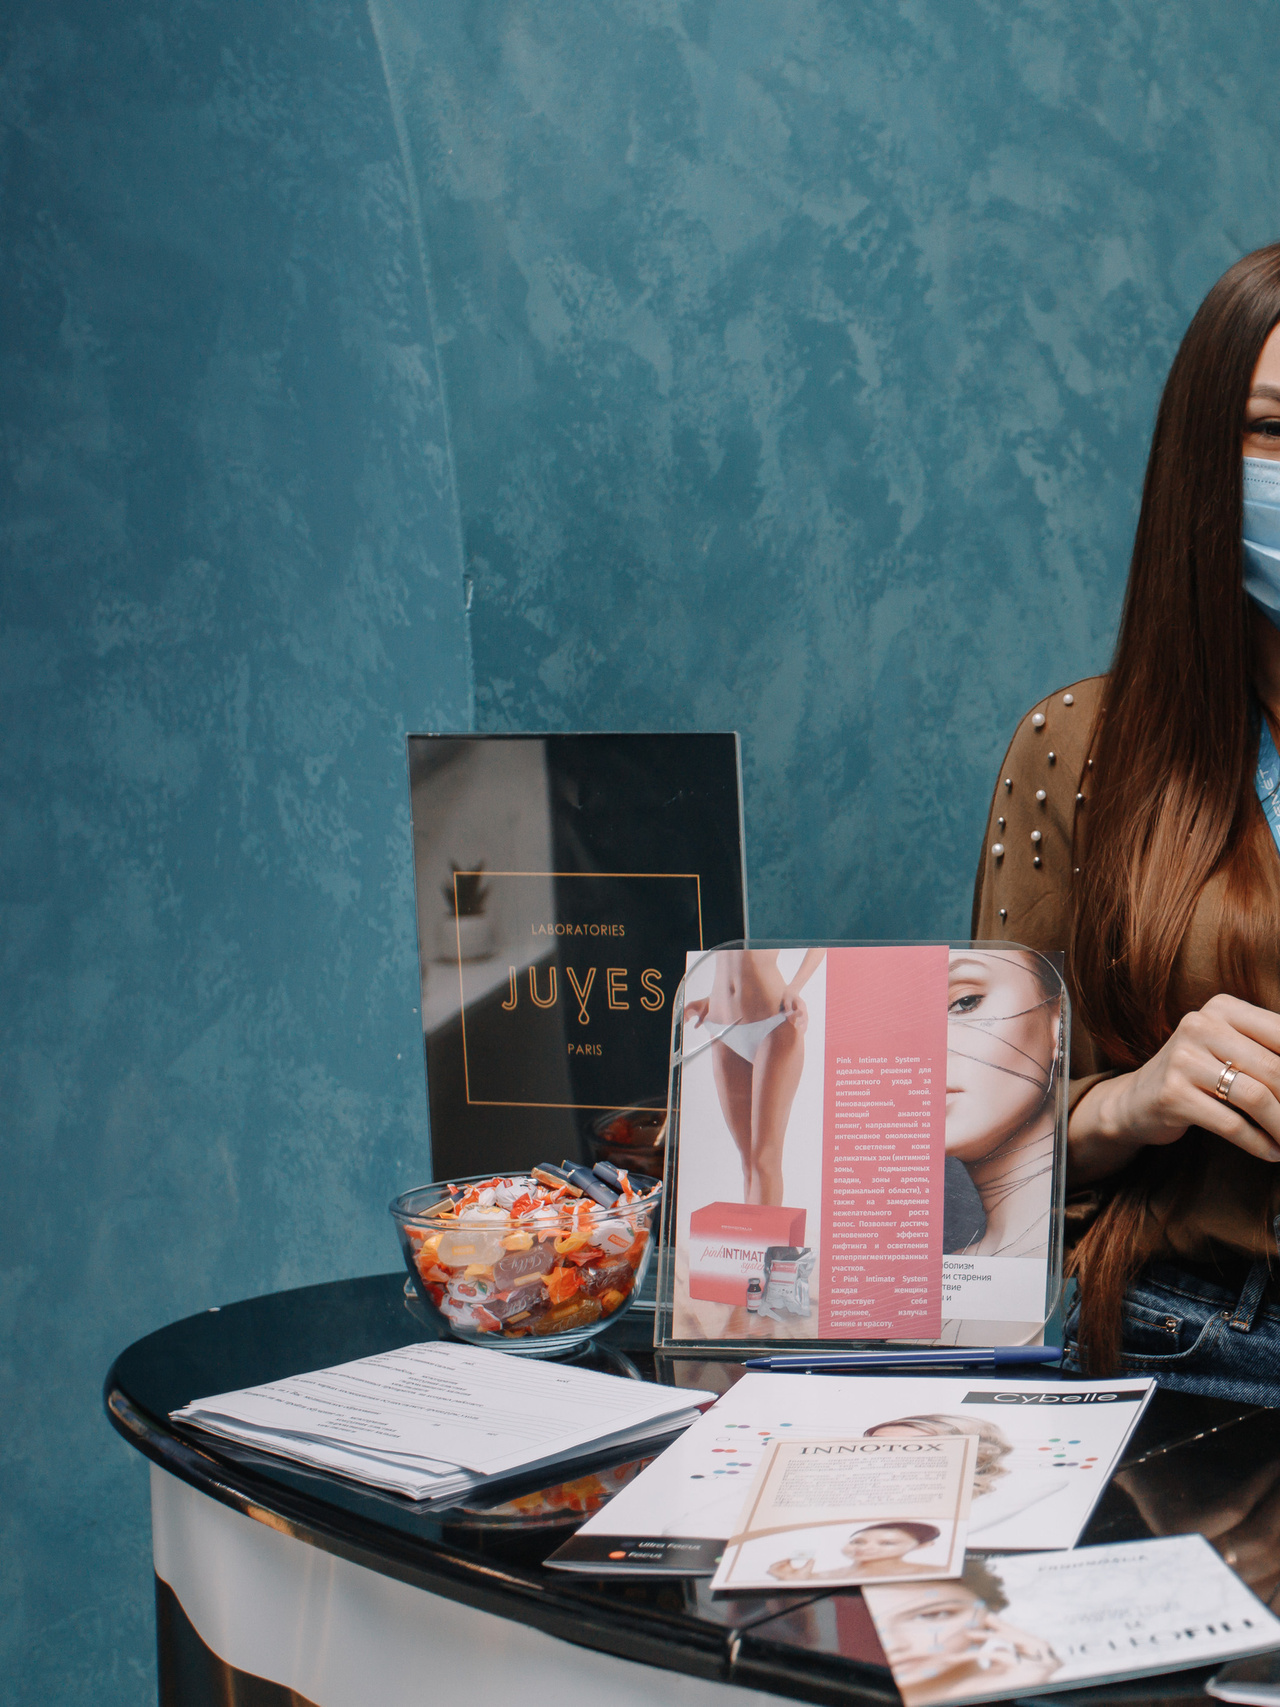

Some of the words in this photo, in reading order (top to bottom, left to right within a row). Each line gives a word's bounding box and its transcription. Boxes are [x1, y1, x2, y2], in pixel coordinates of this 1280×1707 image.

[531, 923, 625, 938] LABORATORIES
[502, 965, 666, 1025] JUVES
[567, 1042, 603, 1056] PARIS
[892, 1078, 912, 1086] ухода
[836, 1100, 895, 1108] Инновационный,
[866, 1121, 918, 1129] направленный
[892, 1154, 930, 1162] (интимной
[834, 1187, 884, 1196] перианальной
[723, 1249, 767, 1262] INTIMAT
[942, 1262, 974, 1270] болизм
[902, 1275, 928, 1283] System
[953, 1274, 991, 1282] старения
[831, 1298, 875, 1306] почувствует
[993, 1393, 1118, 1404] Cybelle
[800, 1443, 944, 1455] INNOTOX
